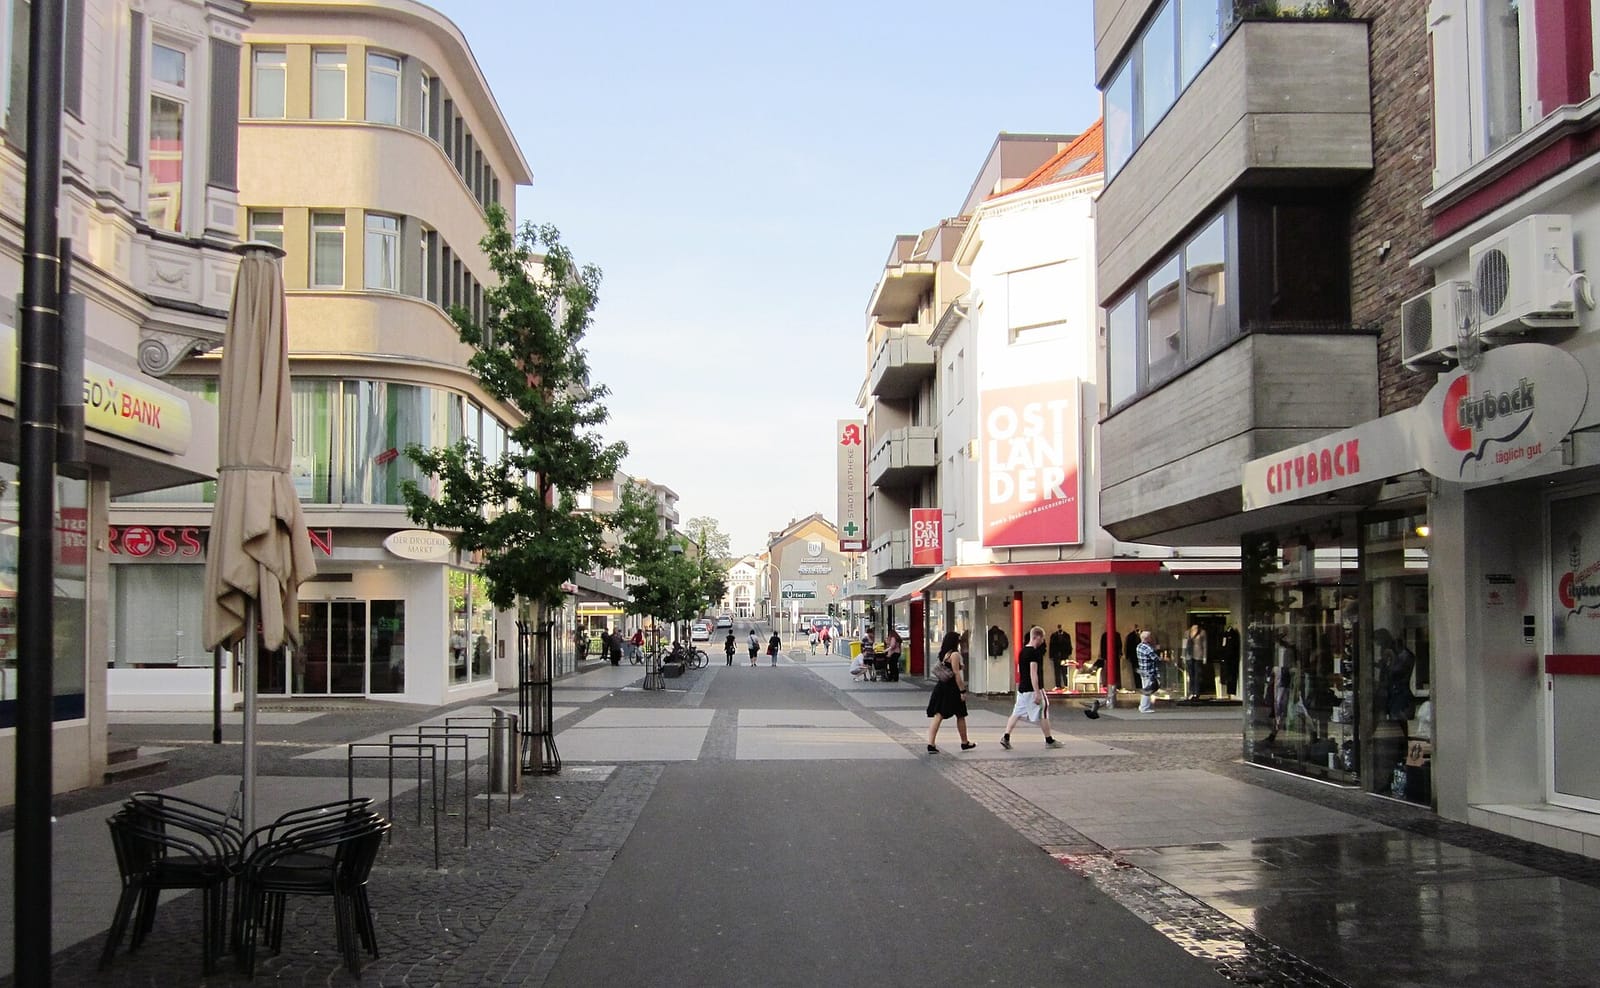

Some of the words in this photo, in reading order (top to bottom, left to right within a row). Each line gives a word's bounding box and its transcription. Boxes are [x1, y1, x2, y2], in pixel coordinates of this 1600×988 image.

[121, 392, 161, 430] BANK
[987, 399, 1069, 441] OST
[1443, 375, 1535, 452] Cityback
[847, 447, 855, 491] APOTHEKE
[988, 435, 1065, 472] LÄN
[1266, 438, 1360, 495] CITYBACK
[1495, 448, 1524, 465] täglich
[1527, 442, 1542, 460] gut
[988, 466, 1068, 505] DER
[847, 492, 855, 518] STADT
[393, 536, 407, 545] DER
[914, 520, 940, 531] OST
[914, 538, 940, 548] DER
